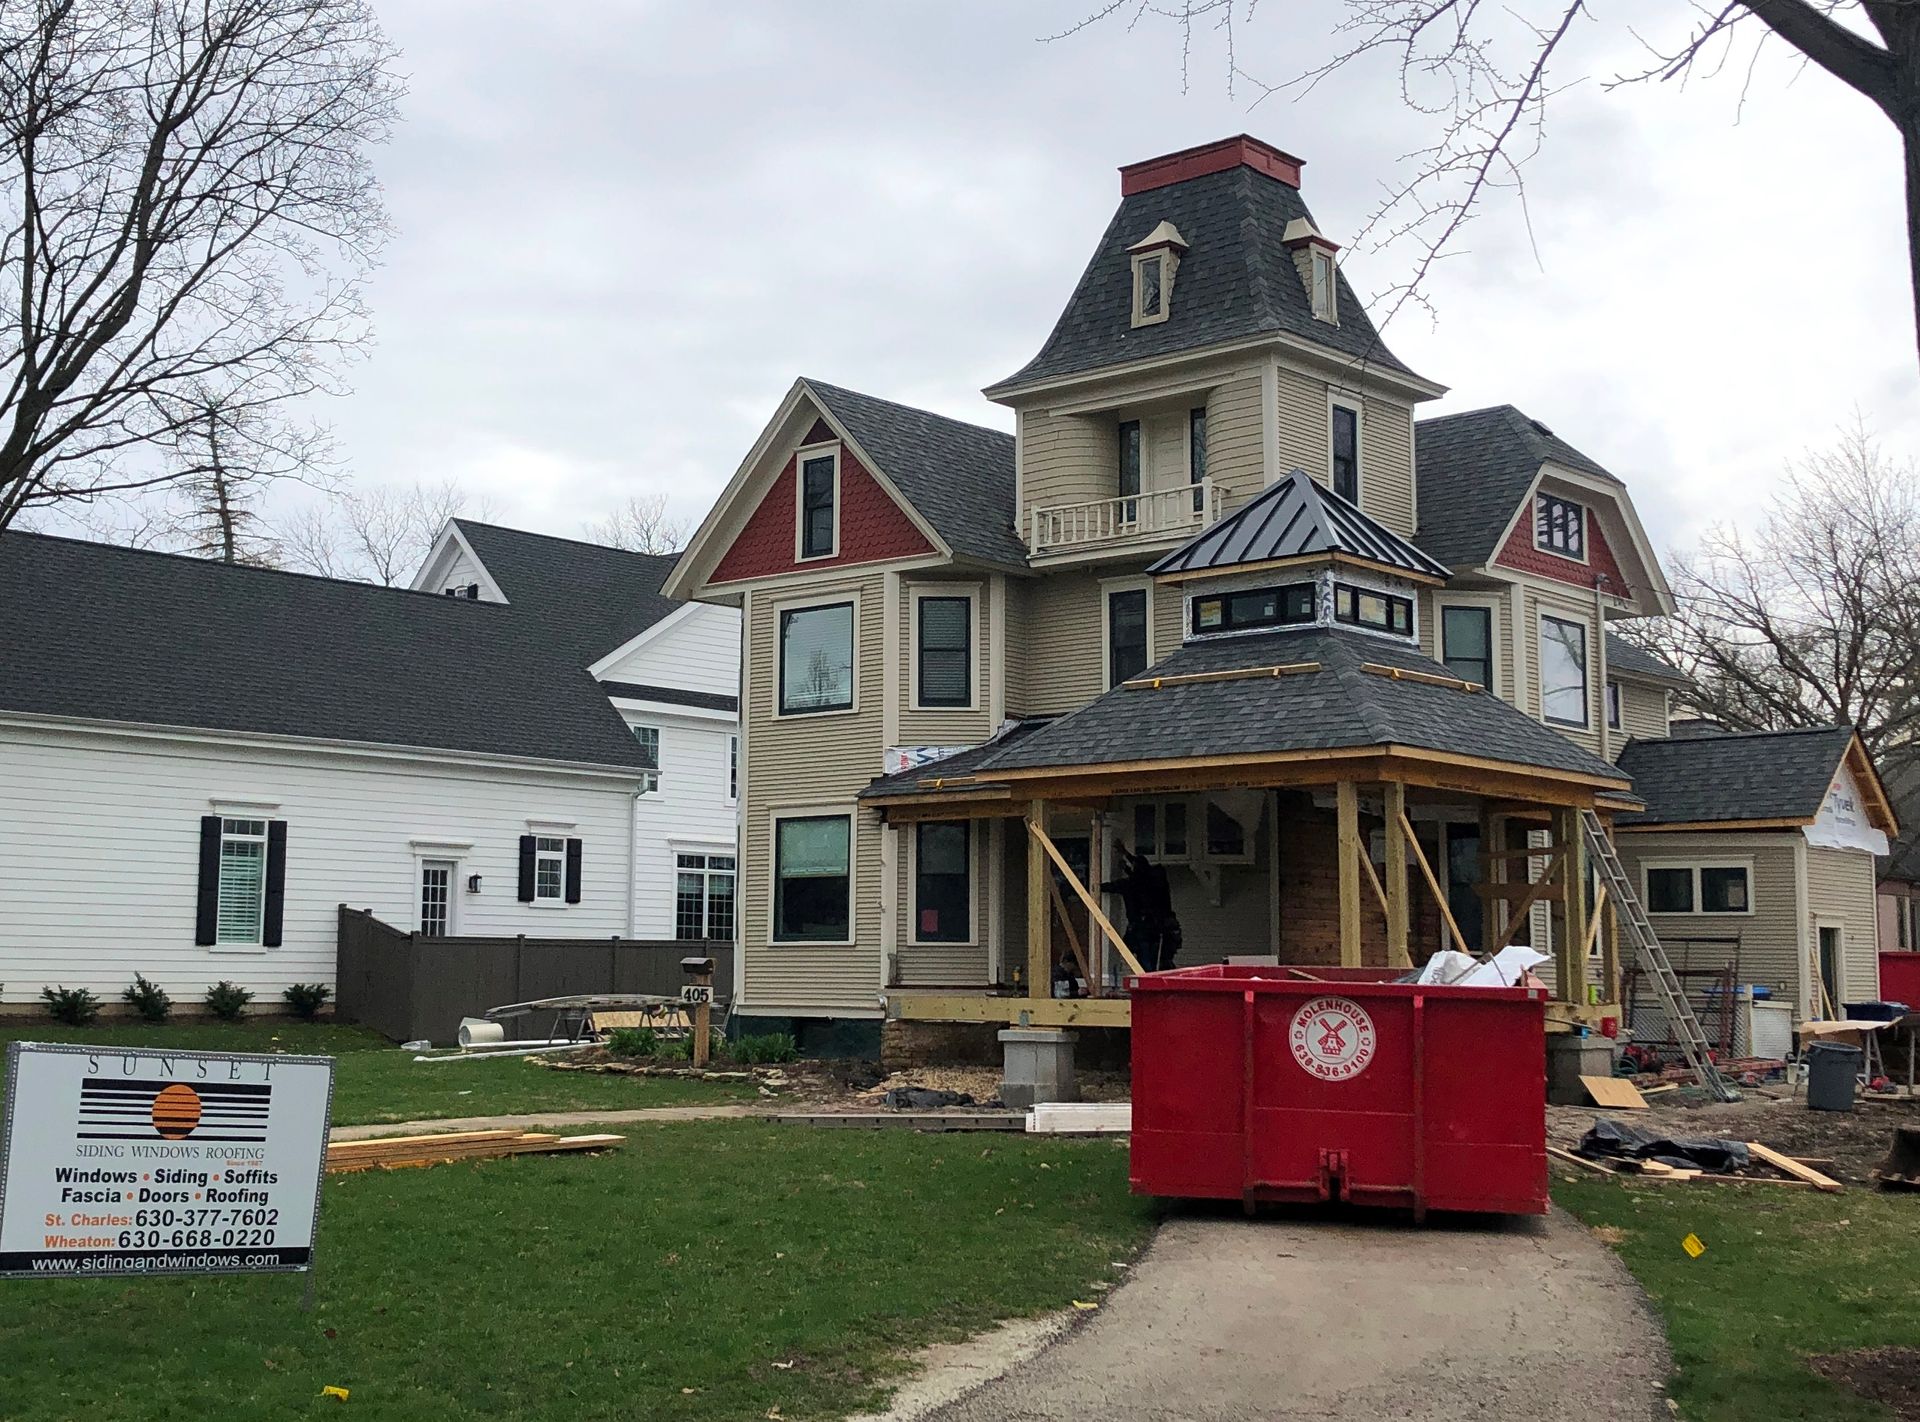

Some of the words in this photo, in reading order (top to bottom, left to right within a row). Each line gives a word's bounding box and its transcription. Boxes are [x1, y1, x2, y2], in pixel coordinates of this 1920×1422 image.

[683, 988, 709, 1002] 405
[1297, 1000, 1370, 1033] MOLENHOUSE
[87, 1054, 276, 1081] SUNSET
[1295, 1044, 1369, 1077] 630-836-9100
[75, 1145, 125, 1158] SIDING
[131, 1146, 200, 1159] WINDOWS
[205, 1147, 265, 1160] ROOFING
[55, 1168, 138, 1183] Windows
[154, 1169, 209, 1187] Siding
[224, 1169, 278, 1184] Soffits
[61, 1188, 121, 1203] Fascia
[138, 1188, 190, 1202] Doors
[205, 1188, 269, 1206] Roofing
[44, 1214, 66, 1226] St.
[71, 1214, 133, 1226] Charles:
[135, 1209, 279, 1227] 630-377-7602
[44, 1235, 116, 1248] Wheaton:
[118, 1229, 275, 1248] 630-668-0220
[32, 1253, 280, 1271] www.sidingandwindows.com
